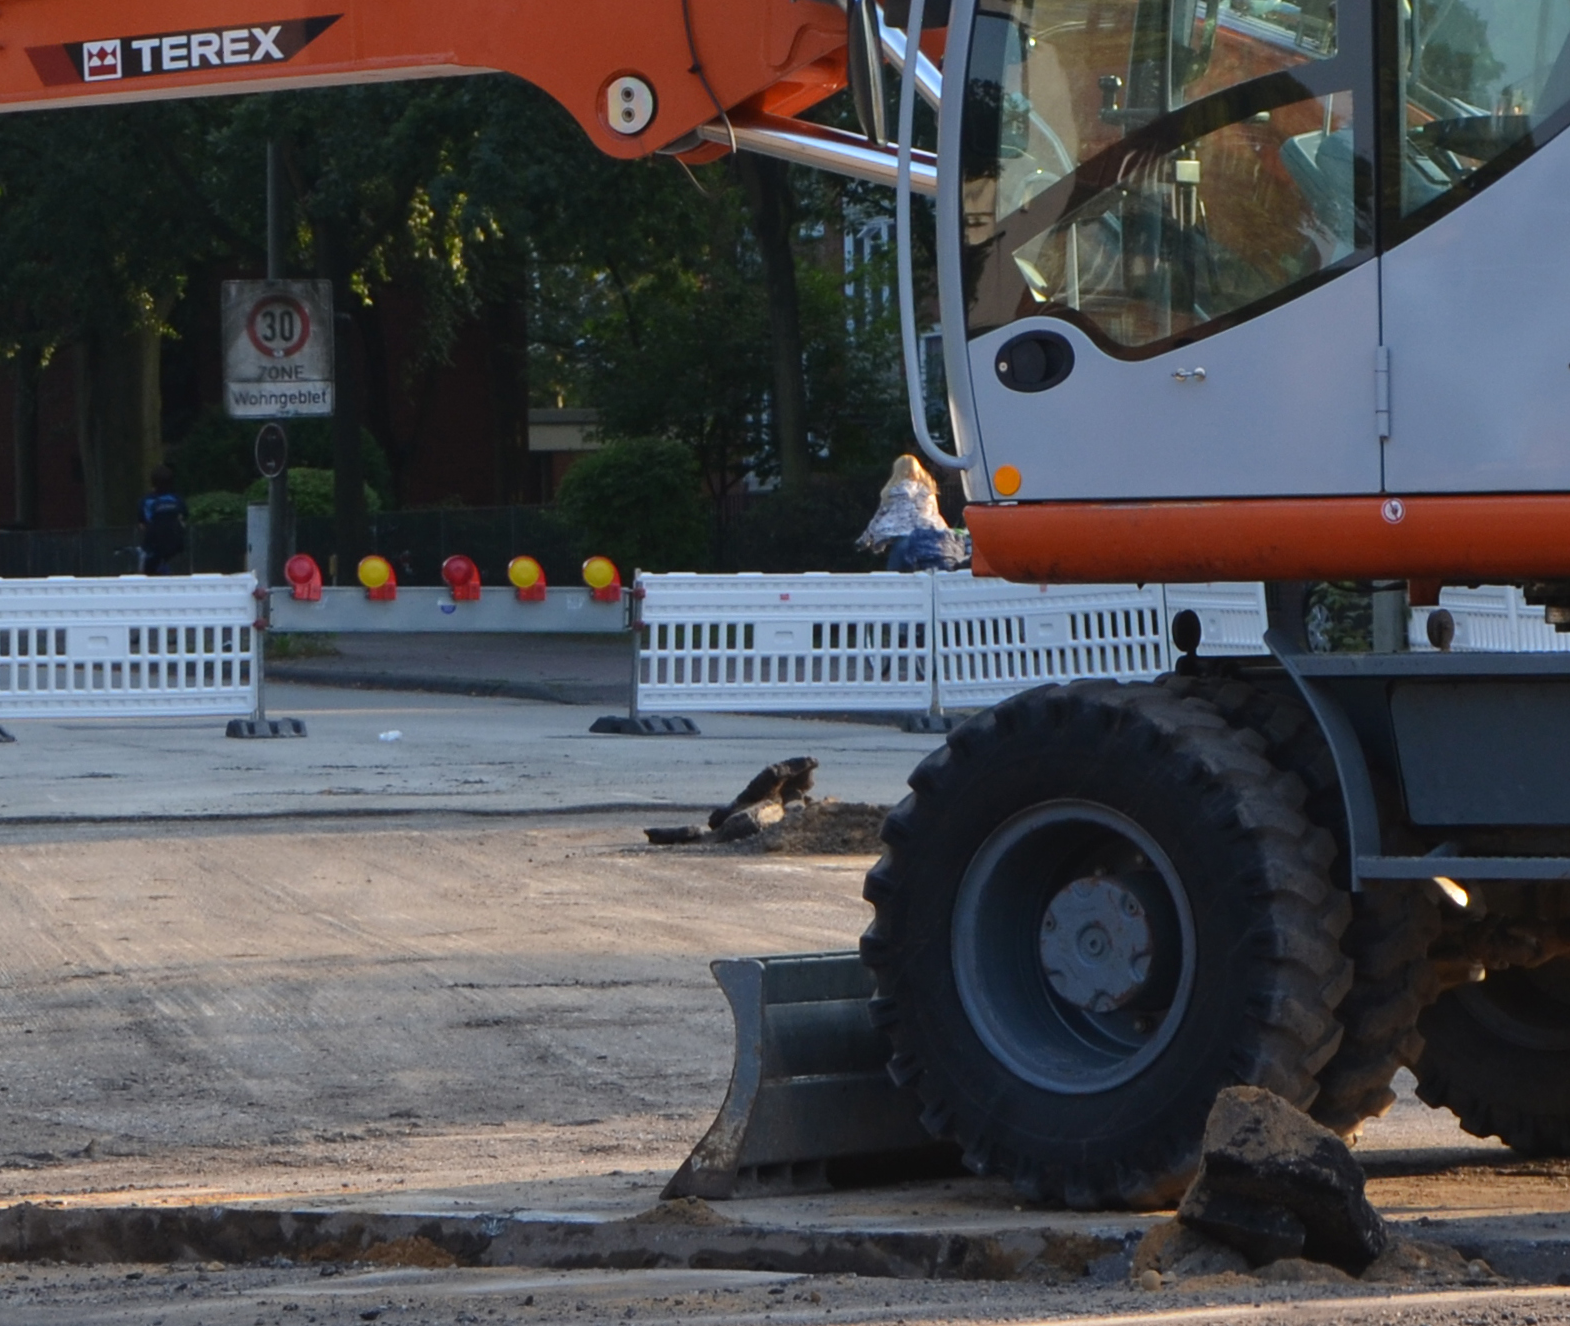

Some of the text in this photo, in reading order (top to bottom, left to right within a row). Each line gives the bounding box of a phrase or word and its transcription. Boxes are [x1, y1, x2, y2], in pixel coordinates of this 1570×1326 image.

[131, 25, 284, 73] TEREX
[262, 311, 294, 343] 30
[258, 365, 305, 380] ZONE
[233, 390, 327, 409] Wohngebiet
